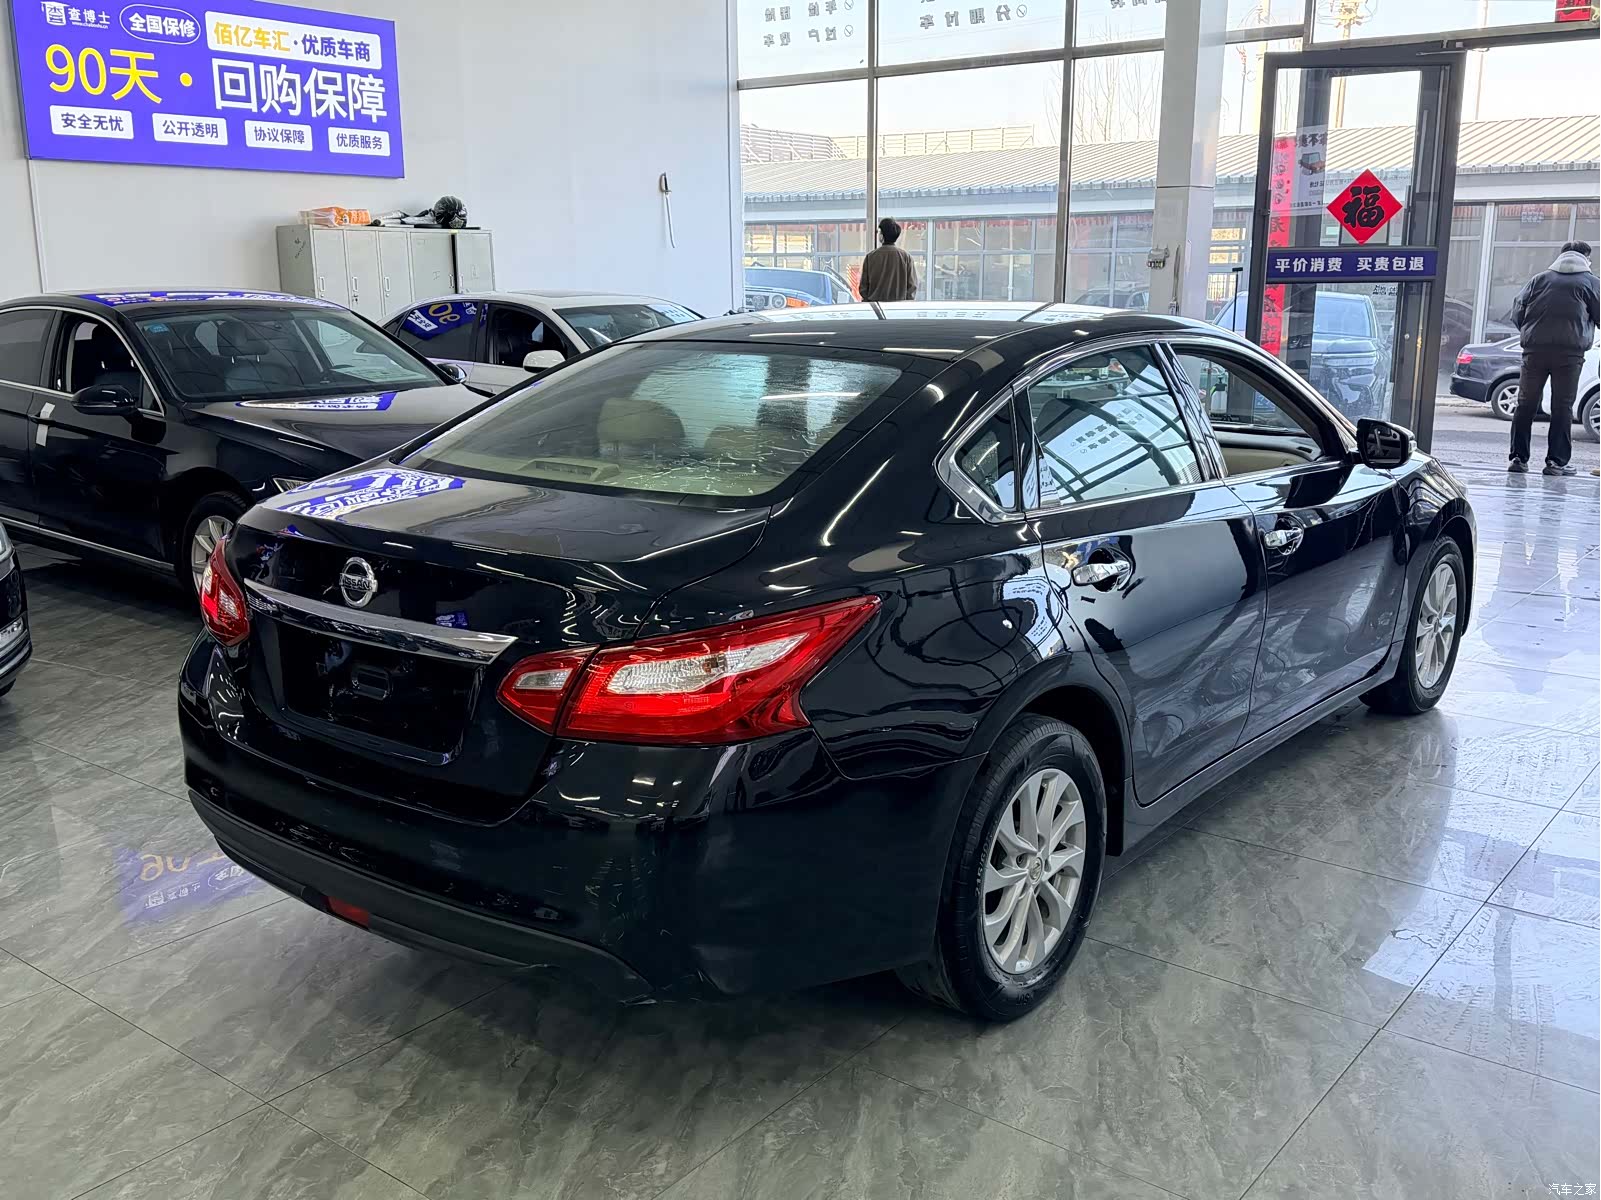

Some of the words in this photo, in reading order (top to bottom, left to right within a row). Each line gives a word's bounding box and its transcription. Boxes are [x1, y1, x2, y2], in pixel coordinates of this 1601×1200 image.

[68, 7, 110, 24] 查博士
[130, 13, 197, 38] 全国保修
[211, 58, 388, 123] 回购保障
[61, 113, 124, 131] 安全无忧
[162, 119, 219, 138] 公开透明
[254, 126, 305, 145] 协议保障
[336, 133, 383, 150] 优质服务
[1341, 185, 1385, 228] 福
[1275, 257, 1342, 272] 平价消费
[1357, 257, 1424, 272] 买贵包退
